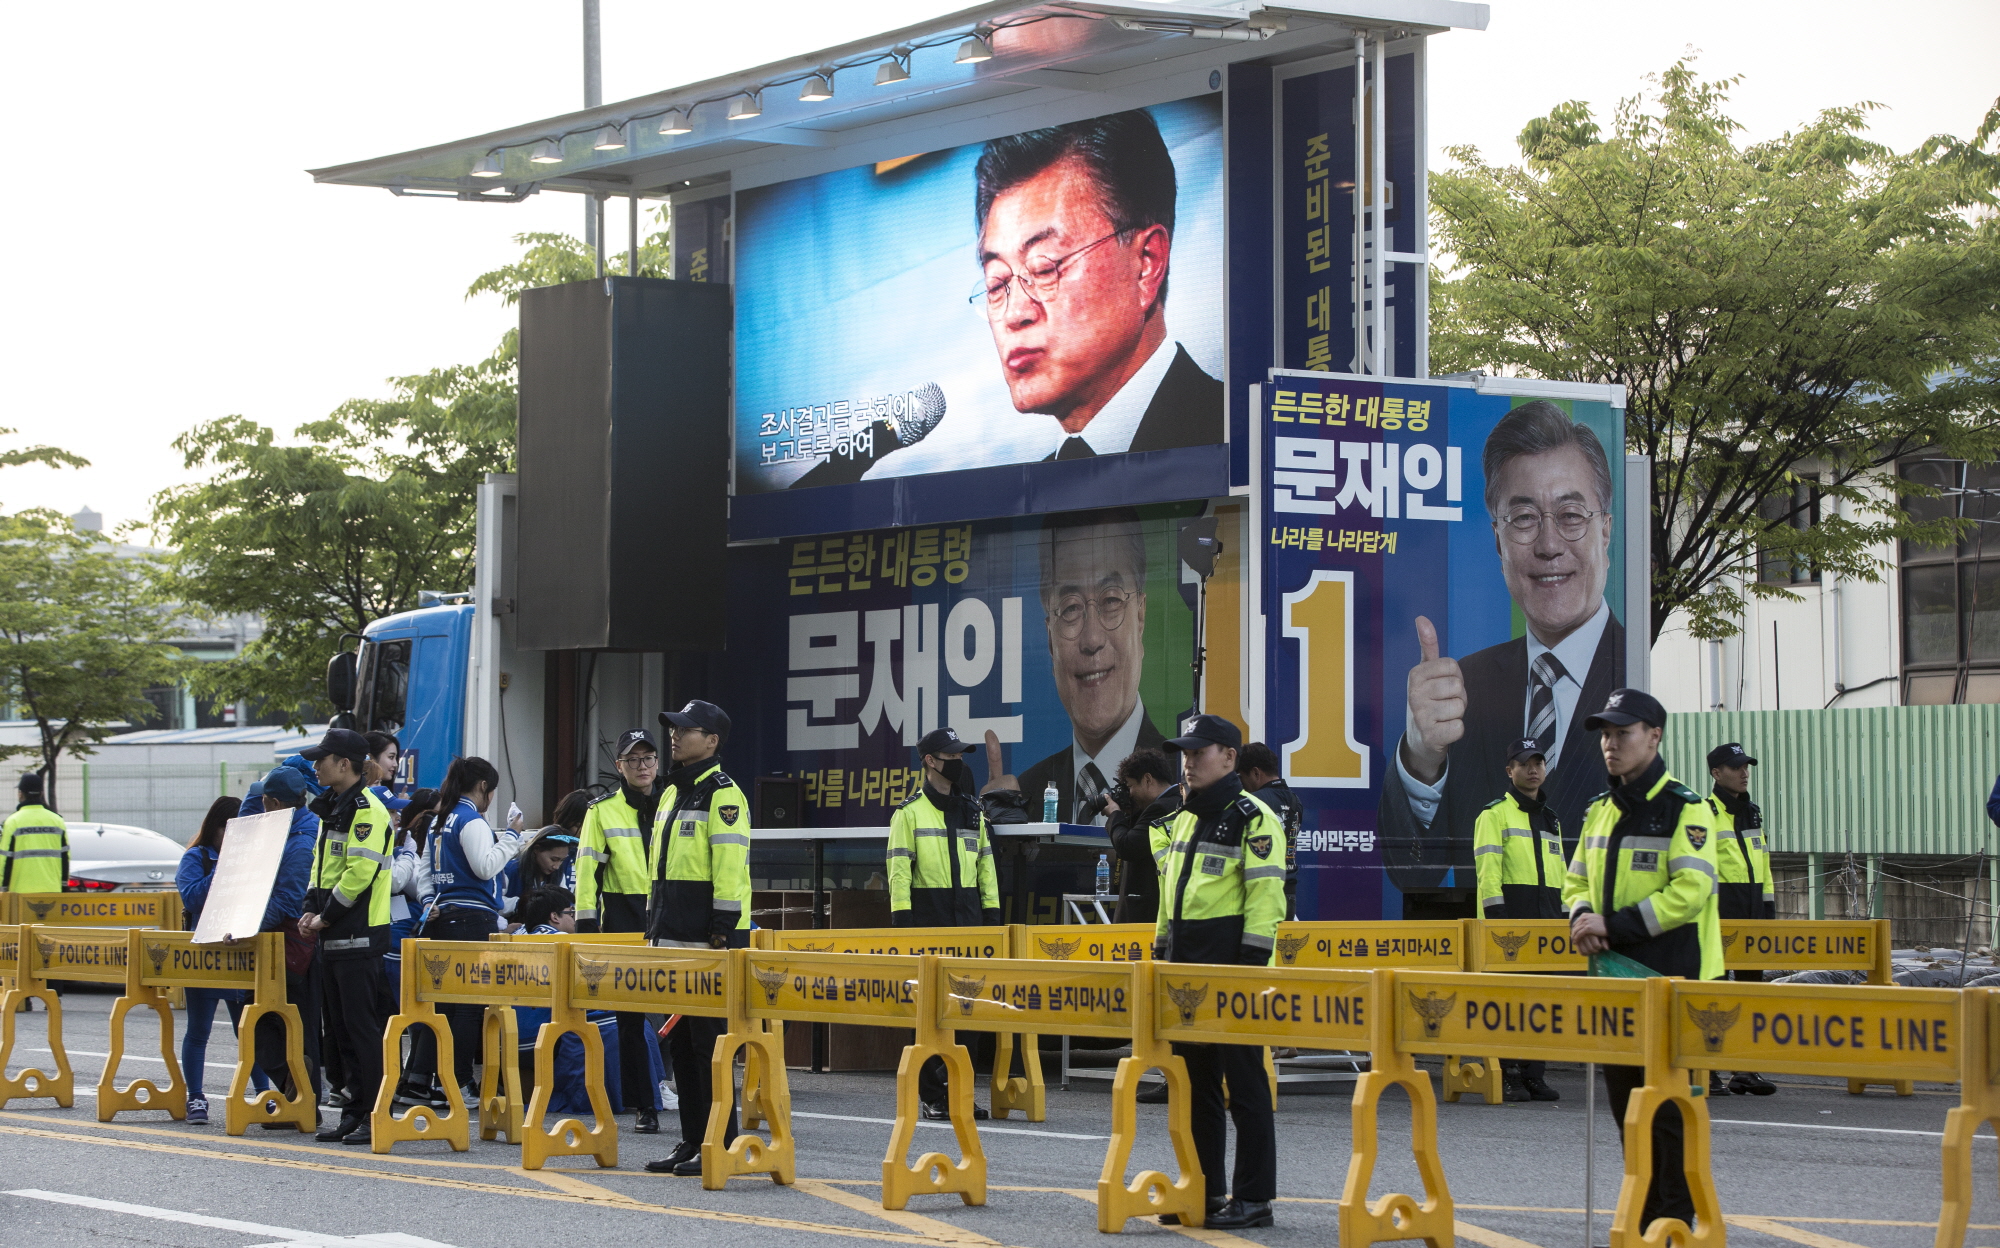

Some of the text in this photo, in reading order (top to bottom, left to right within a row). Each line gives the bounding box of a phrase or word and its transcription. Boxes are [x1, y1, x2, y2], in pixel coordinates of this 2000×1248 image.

[1304, 133, 1332, 372] 준비된 대통
[759, 392, 913, 437] 조사결과를 국회에
[1271, 390, 1430, 432] 든든한 대통령
[759, 428, 874, 466] 보고토록 하여
[1273, 436, 1463, 522] 문재인
[1271, 526, 1398, 554] 나라를 나라답게
[788, 524, 972, 595] 든든한 대통령
[787, 596, 1023, 751] 문재인
[1282, 570, 1370, 789] 1
[407, 755, 415, 785] 1
[788, 768, 844, 808] 라를
[20, 826, 56, 834] POLICE
[1296, 830, 1376, 852] 불어민주당
[61, 903, 156, 916] POLICE LINE
[0, 943, 18, 960] INE
[59, 945, 128, 966] POLICE LINE
[1089, 943, 1104, 961] 이
[1111, 942, 1142, 961] 선을
[1316, 938, 1453, 957] 이 선을 넘지마시오
[1537, 936, 1576, 954] POL
[1745, 936, 1866, 954] POLICE LINE
[174, 950, 254, 971] POLICE LINE
[455, 963, 550, 986] 이 선을 넘지마시오
[614, 967, 722, 995] POLICE LINE
[794, 976, 914, 1004] 이 선을 넘지마시오
[992, 983, 1127, 1012] 이 선을 넘지마시오
[1216, 991, 1364, 1025] POLICE LINE
[1466, 1001, 1634, 1037] POLICE LINE
[1753, 1013, 1947, 1052] POLICE LINE
